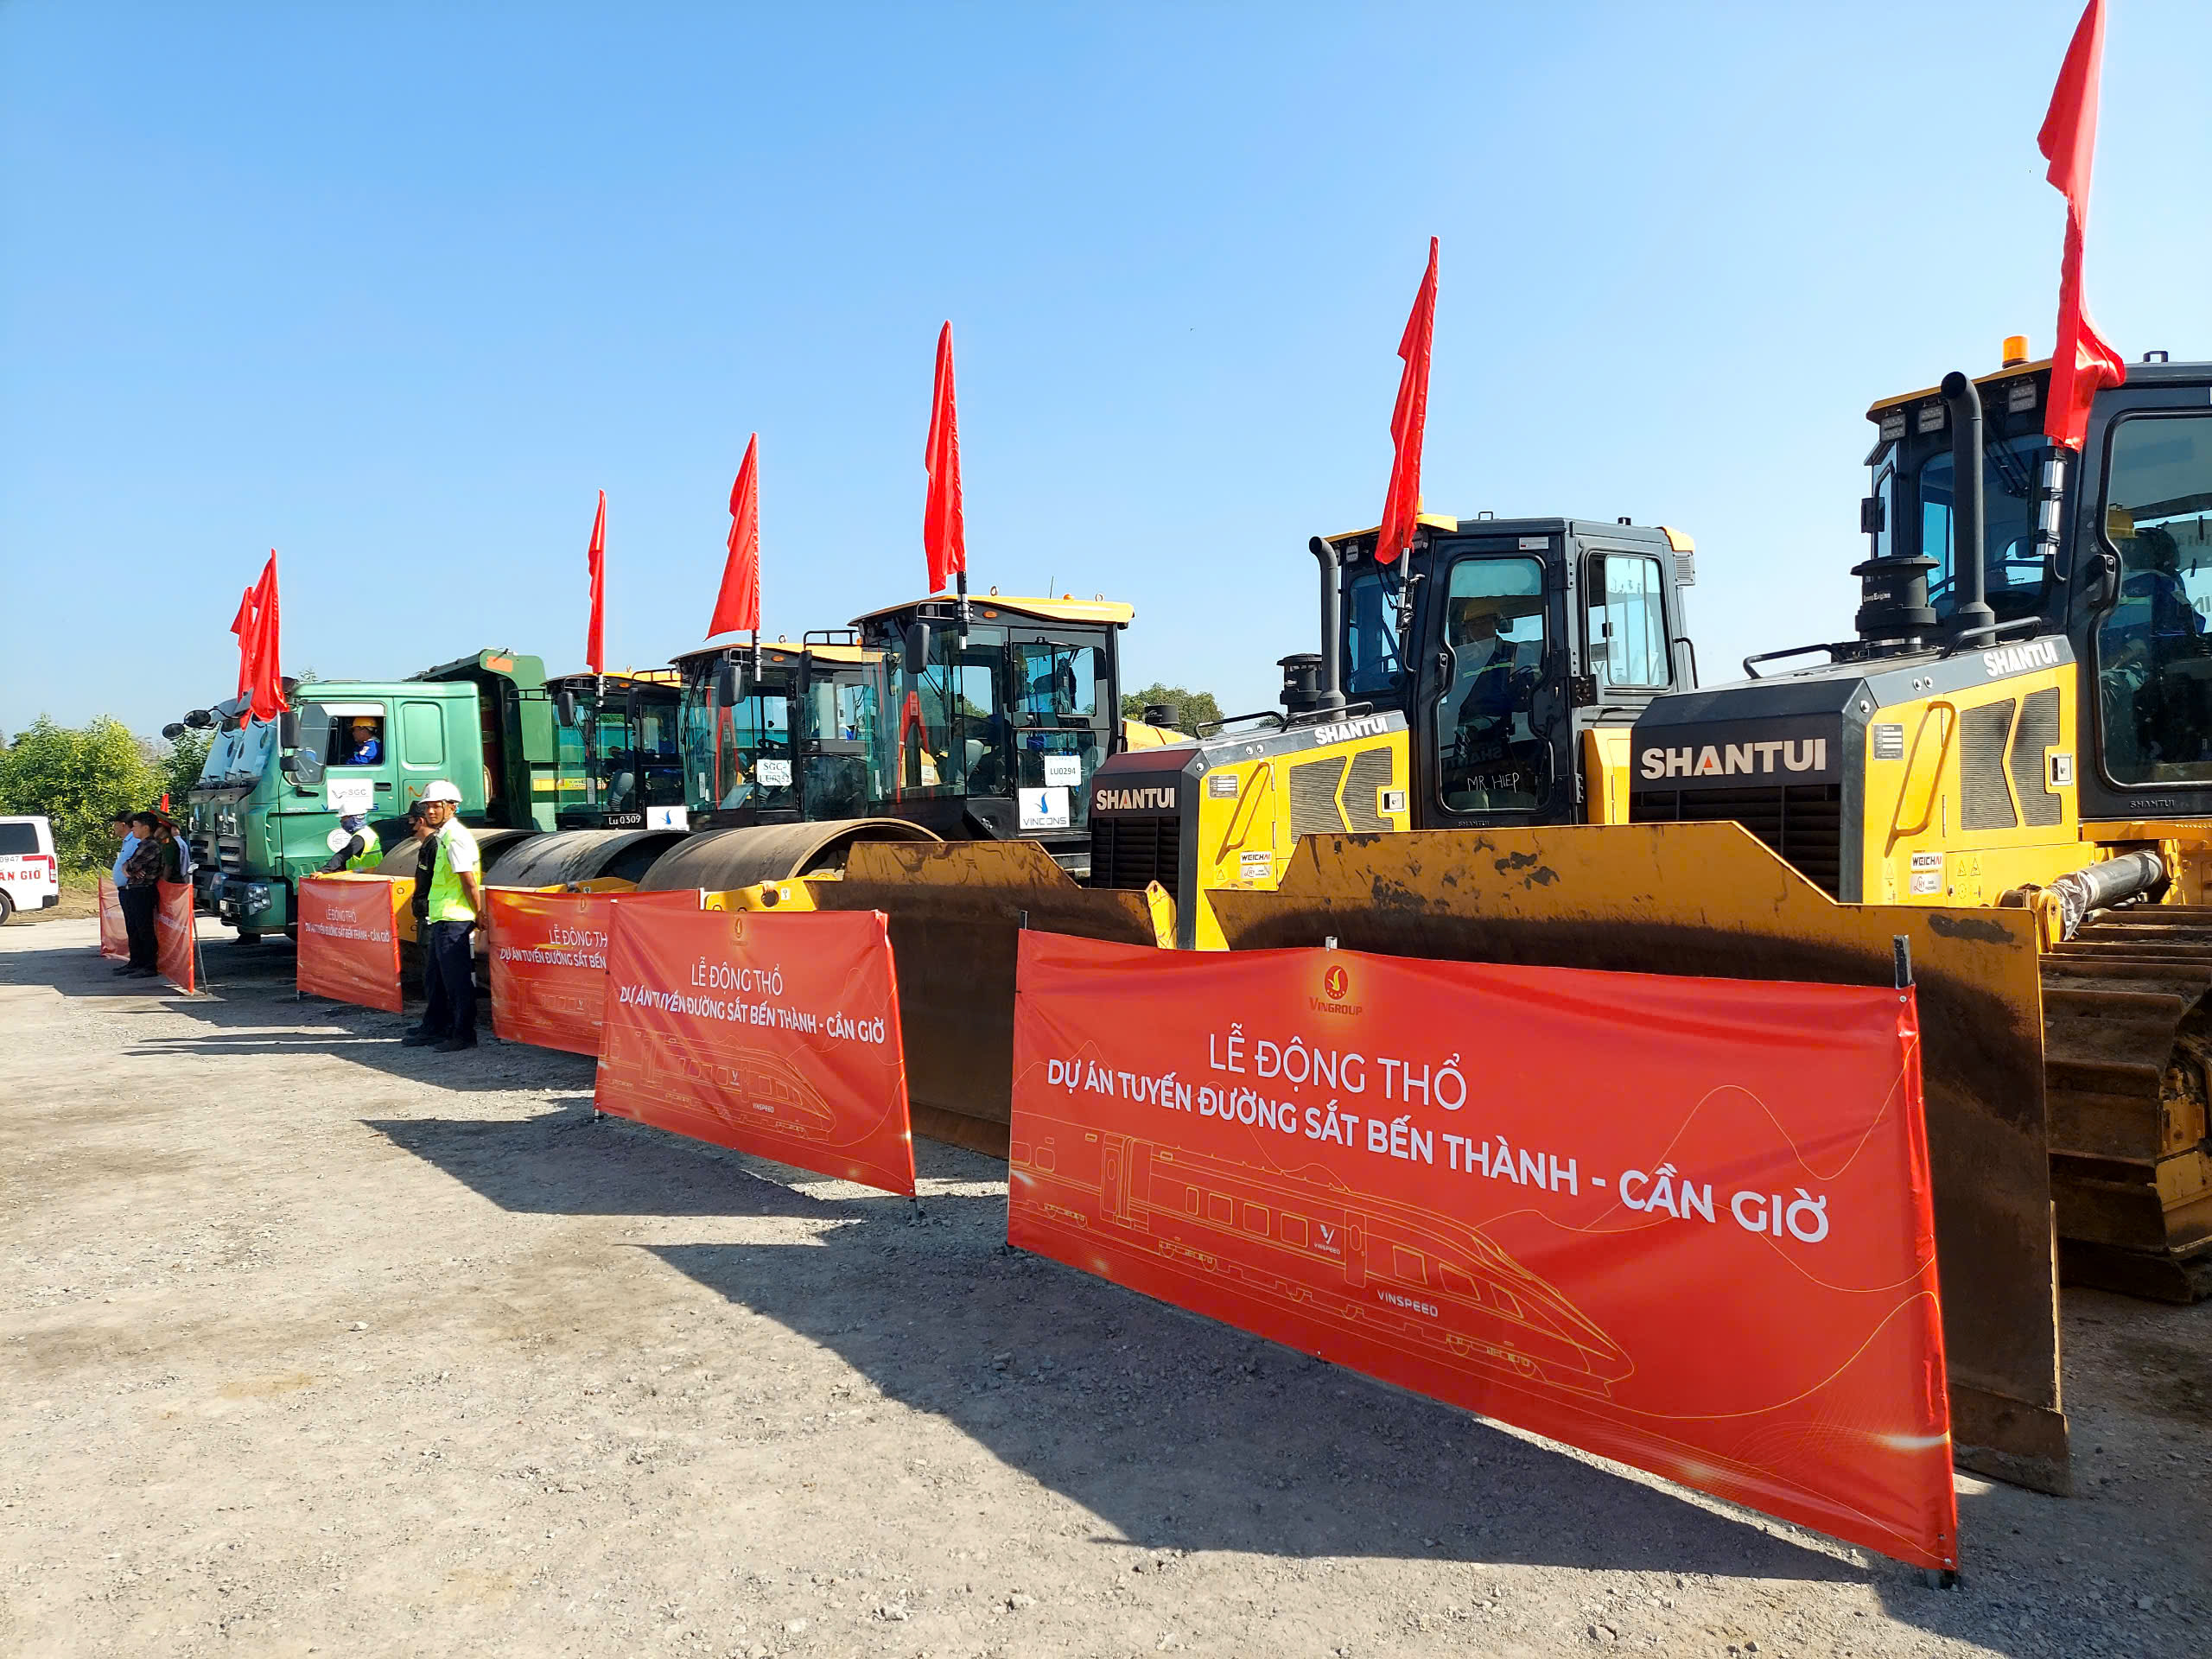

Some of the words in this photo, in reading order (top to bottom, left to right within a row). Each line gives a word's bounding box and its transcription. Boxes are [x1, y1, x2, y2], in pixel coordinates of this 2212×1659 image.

[1983, 641, 2059, 677] SHANTUI
[1314, 716, 1389, 745] SHANTUI
[1640, 738, 1827, 779] SHANTUI
[1467, 775, 1488, 792] MR
[1096, 787, 1175, 810] SHANTUI
[2130, 799, 2175, 809] SHANTUI
[620, 815, 641, 824] 0309
[1023, 817, 1067, 826] VINCONS
[1242, 853, 1271, 861] WEICHAI
[1912, 855, 1942, 866] WEICHAI
[549, 924, 561, 944] LỄ
[563, 926, 592, 948] ĐỘNG
[594, 931, 607, 948] TH
[499, 947, 511, 963] DỰ
[512, 947, 522, 962] ÁN
[523, 947, 544, 963] TUYẾN
[545, 950, 573, 967] ĐƯỜNG
[574, 949, 588, 968] SẮT
[589, 951, 607, 969] BẾN
[691, 956, 706, 987] LỄ
[709, 961, 751, 995] ĐỘNG
[753, 963, 783, 995] THỔ
[620, 985, 636, 1007] DỰ
[635, 985, 652, 1007] ÁN
[651, 990, 685, 1013] TUYẾN
[686, 995, 725, 1020] ĐƯỜNG
[727, 995, 748, 1023] SẮT
[750, 1001, 775, 1027] BẾN
[778, 1007, 817, 1034] THÀNH
[826, 1011, 855, 1039] CẦN
[857, 1017, 885, 1044] GIỜ
[1210, 1022, 1245, 1073] LỄ
[1254, 1035, 1365, 1094] ĐỘNG
[1377, 1052, 1467, 1110] THỔ
[1047, 1058, 1081, 1094] DỰ
[1084, 1060, 1114, 1096] ÁN
[1117, 1072, 1192, 1113] TUYẾN
[1198, 1086, 1297, 1134] ĐƯỜNG
[1305, 1099, 1359, 1147] SẮT
[1368, 1115, 1433, 1165] BẾN
[1442, 1134, 1578, 1196] THÀNH
[1592, 1176, 1605, 1187] -
[1619, 1162, 1715, 1223] CẦN
[1731, 1187, 1829, 1243] GIỜ
[1314, 1242, 1340, 1255] VINSPEED
[1376, 1288, 1439, 1318] VINSPEED
